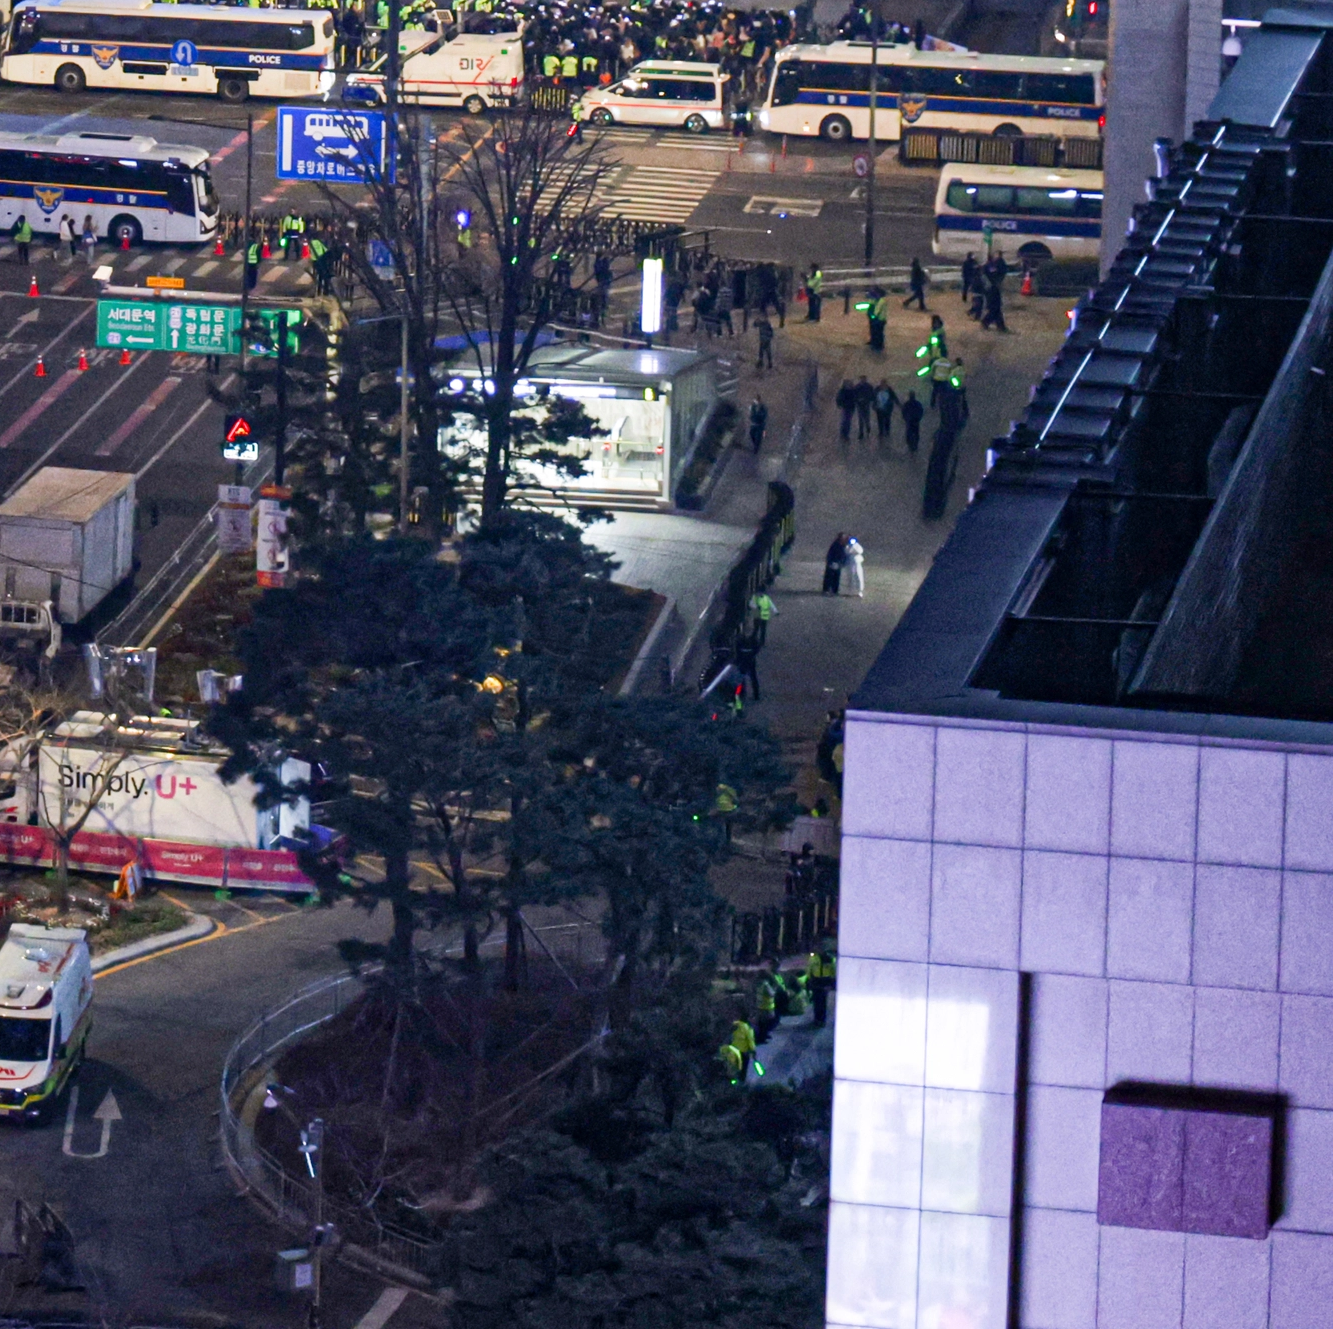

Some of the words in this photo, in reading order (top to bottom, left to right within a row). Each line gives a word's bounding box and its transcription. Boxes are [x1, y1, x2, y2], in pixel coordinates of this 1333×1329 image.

[248, 54, 282, 65] POLICE
[1047, 106, 1080, 118] POLICE
[107, 306, 156, 323] 서대문역
[185, 308, 226, 323] 독립문
[185, 323, 226, 337] 광화문
[57, 764, 149, 800] Simply.
[156, 774, 197, 800] U+
[190, 854, 204, 862] U+
